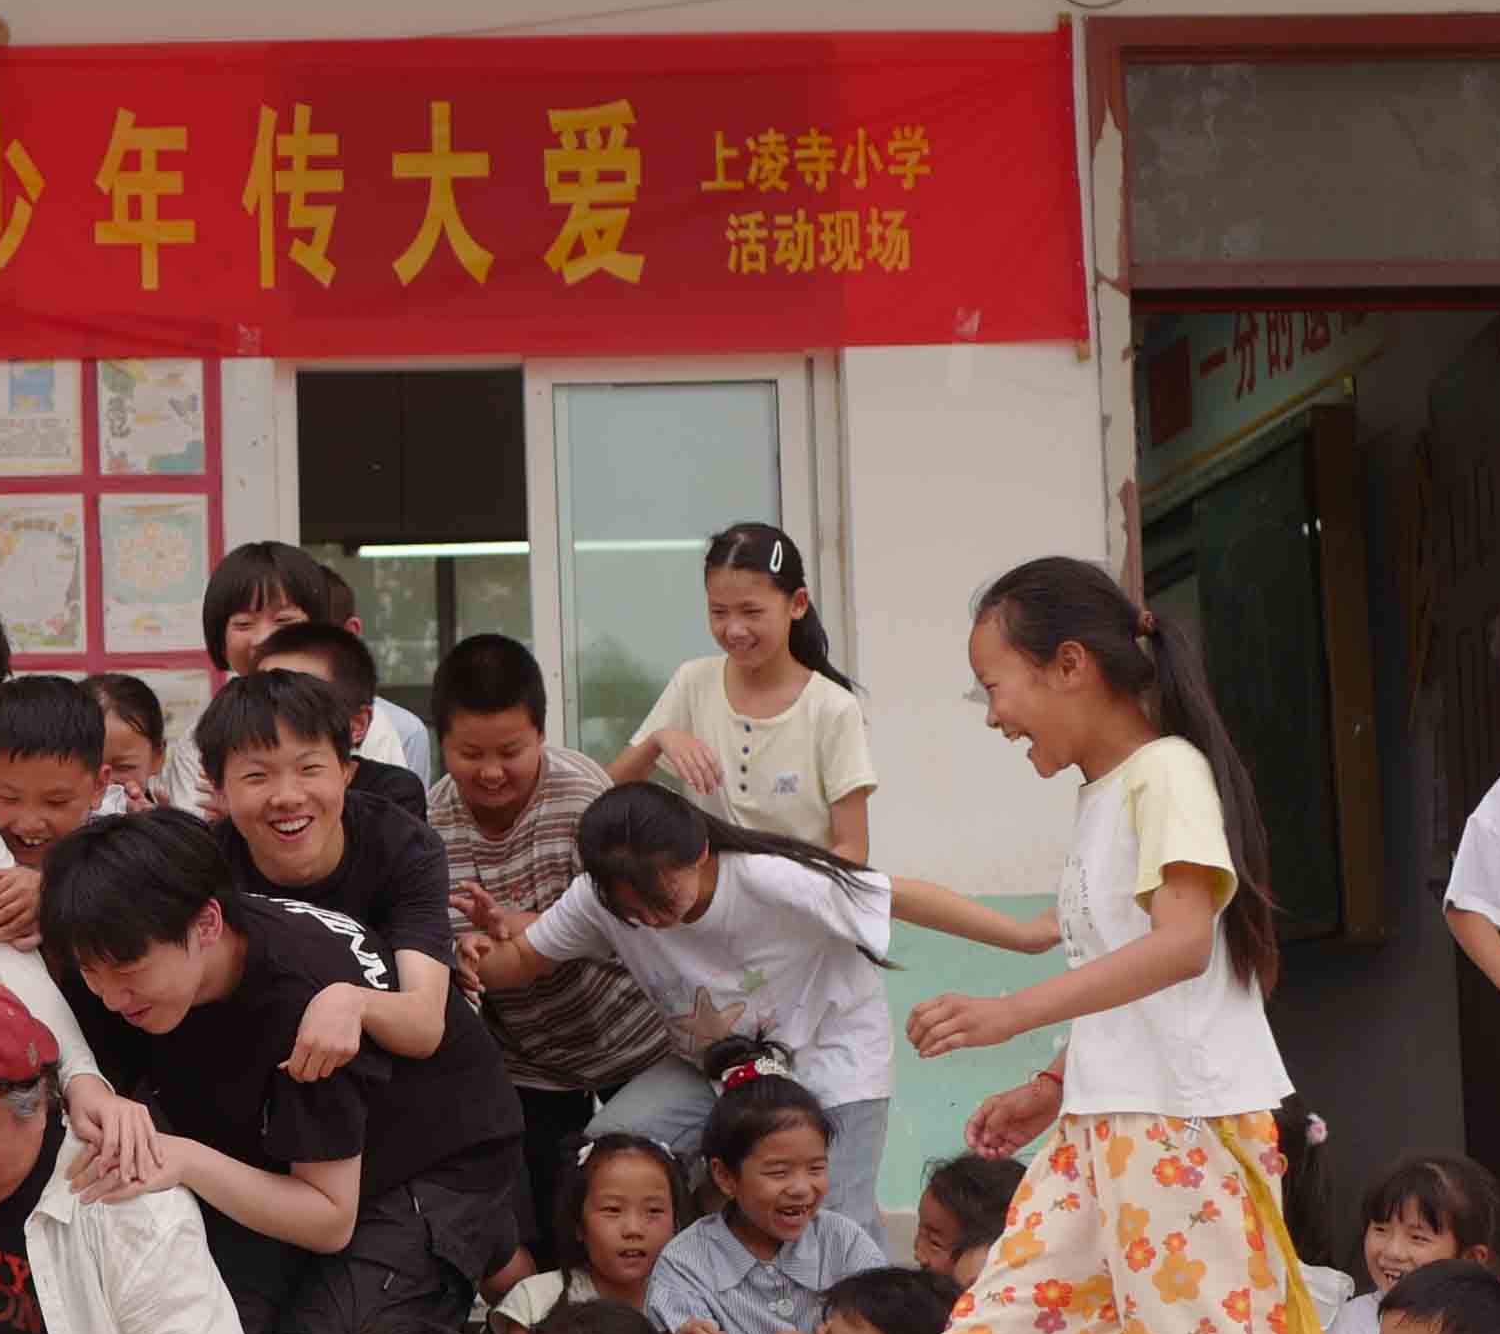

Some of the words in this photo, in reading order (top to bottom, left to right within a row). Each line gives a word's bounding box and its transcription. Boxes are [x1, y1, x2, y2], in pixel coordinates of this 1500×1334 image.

[701, 126, 932, 192] 上凌寺小学
[725, 207, 912, 274] 活动现场
